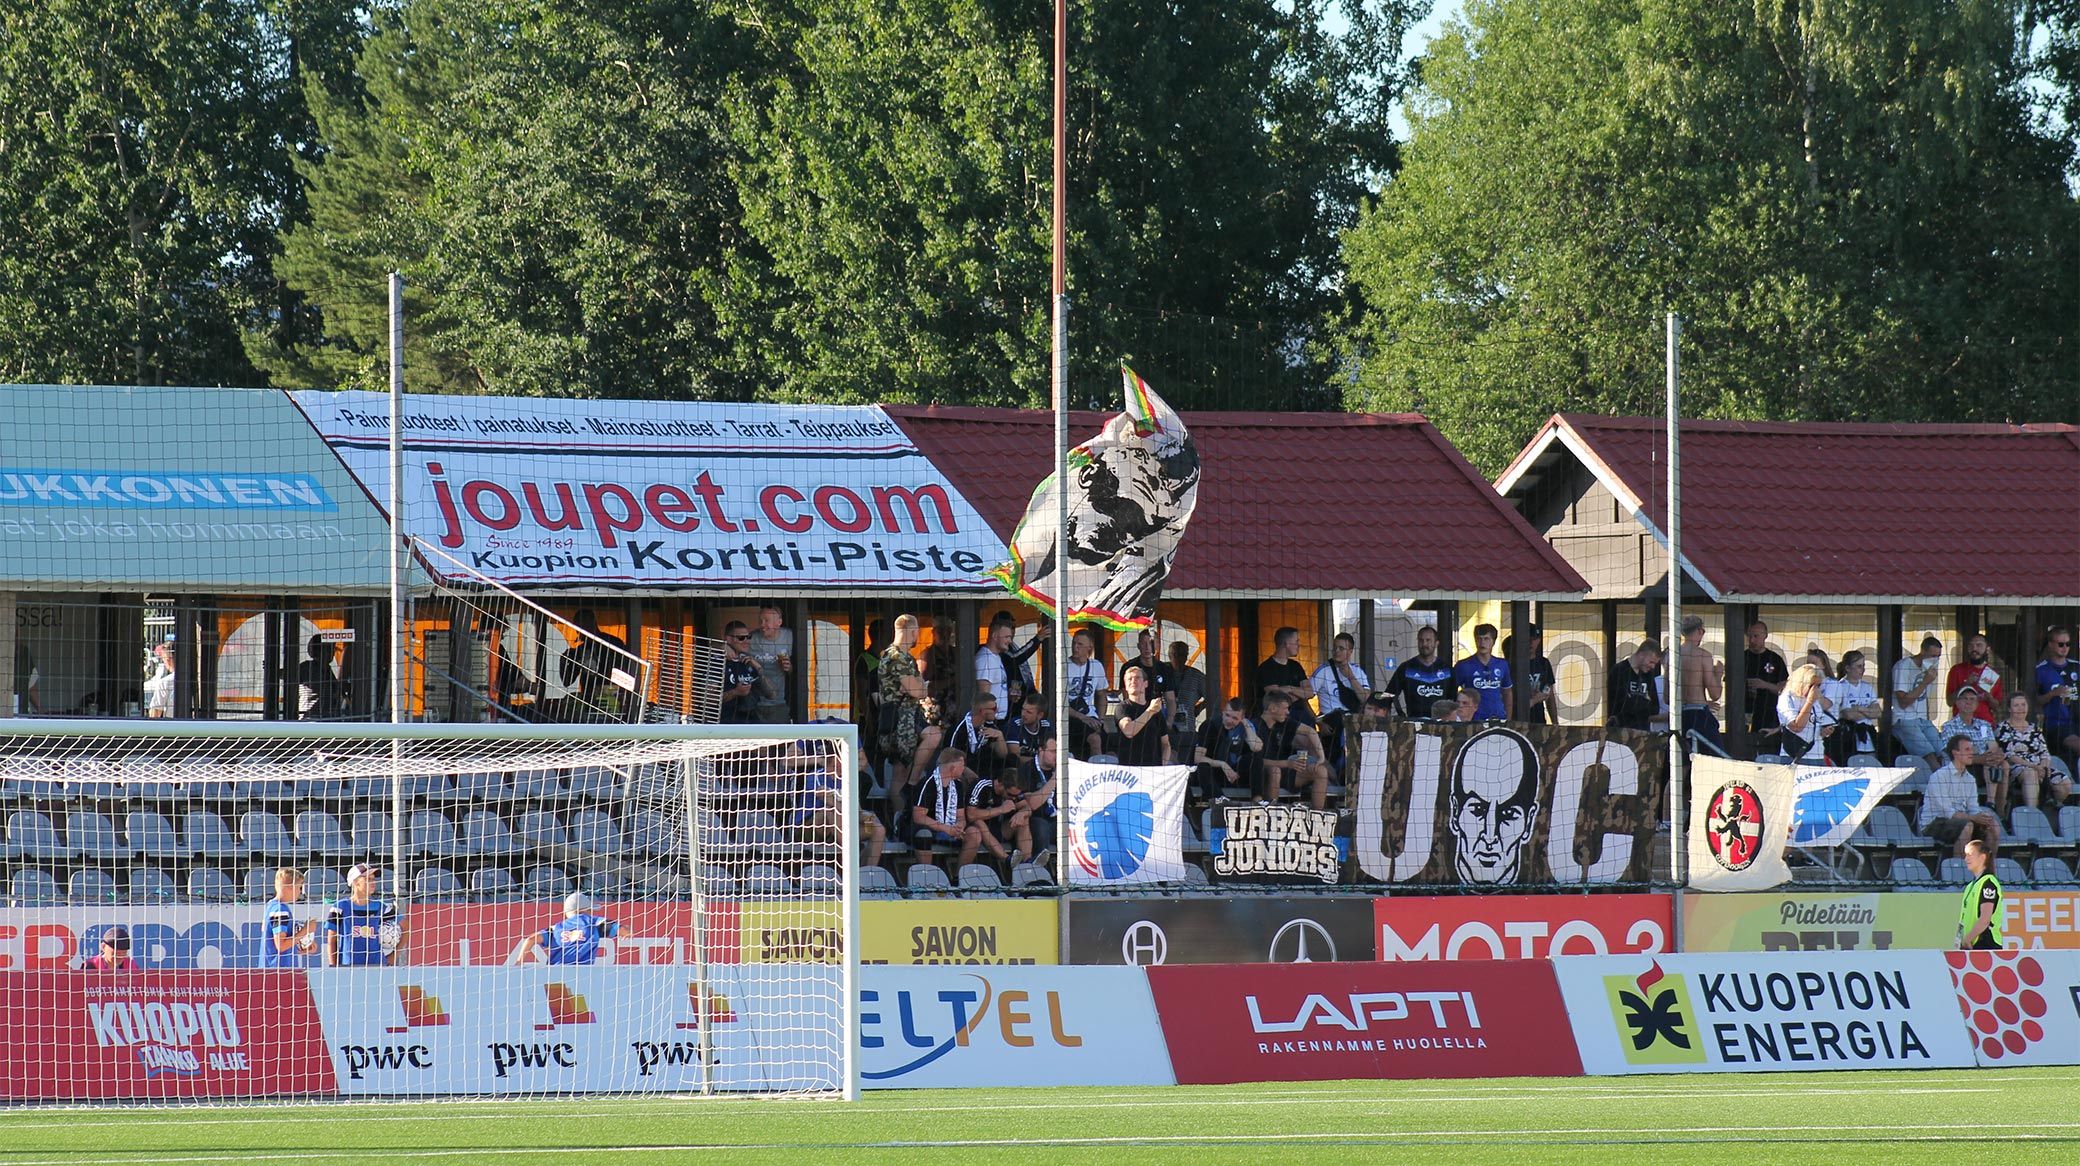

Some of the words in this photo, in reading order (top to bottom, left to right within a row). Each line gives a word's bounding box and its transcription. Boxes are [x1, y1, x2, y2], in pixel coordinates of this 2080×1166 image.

[340, 409, 463, 432] Painouotteet
[473, 416, 578, 436] painatukset
[588, 418, 721, 437] Mainostuotteet
[725, 420, 783, 438] Tarrat
[790, 419, 900, 441] Teippaukset
[0, 473, 323, 505] UKKONEN
[426, 462, 959, 549] joupet.com
[46, 515, 137, 541] joka
[486, 535, 530, 549] Since
[537, 537, 573, 549] 1989
[472, 551, 619, 572] Kuopion
[627, 540, 984, 573] Kortti-Piste
[1074, 769, 1139, 804] KØBENHAVN
[1226, 808, 1337, 845] URBAN
[1216, 840, 1338, 875] JUNIORS
[1780, 900, 1875, 925] Pidetään
[911, 925, 997, 957] SAVON
[1382, 919, 1609, 961] MOTO
[1698, 970, 1911, 1013] KUOPION
[88, 1002, 241, 1047] KUOPIO
[860, 990, 1082, 1048] ELTEL
[1245, 991, 1481, 1033] LAPTI
[140, 1045, 200, 1071] TAHKO
[209, 1053, 249, 1071] ALUE
[1258, 1039, 1387, 1054] RAKENNAMME
[1393, 1037, 1487, 1051] HUOLELLA
[1713, 1020, 1931, 1063] ENERGIA
[340, 1044, 433, 1080] pwc
[488, 1042, 578, 1078] pwc
